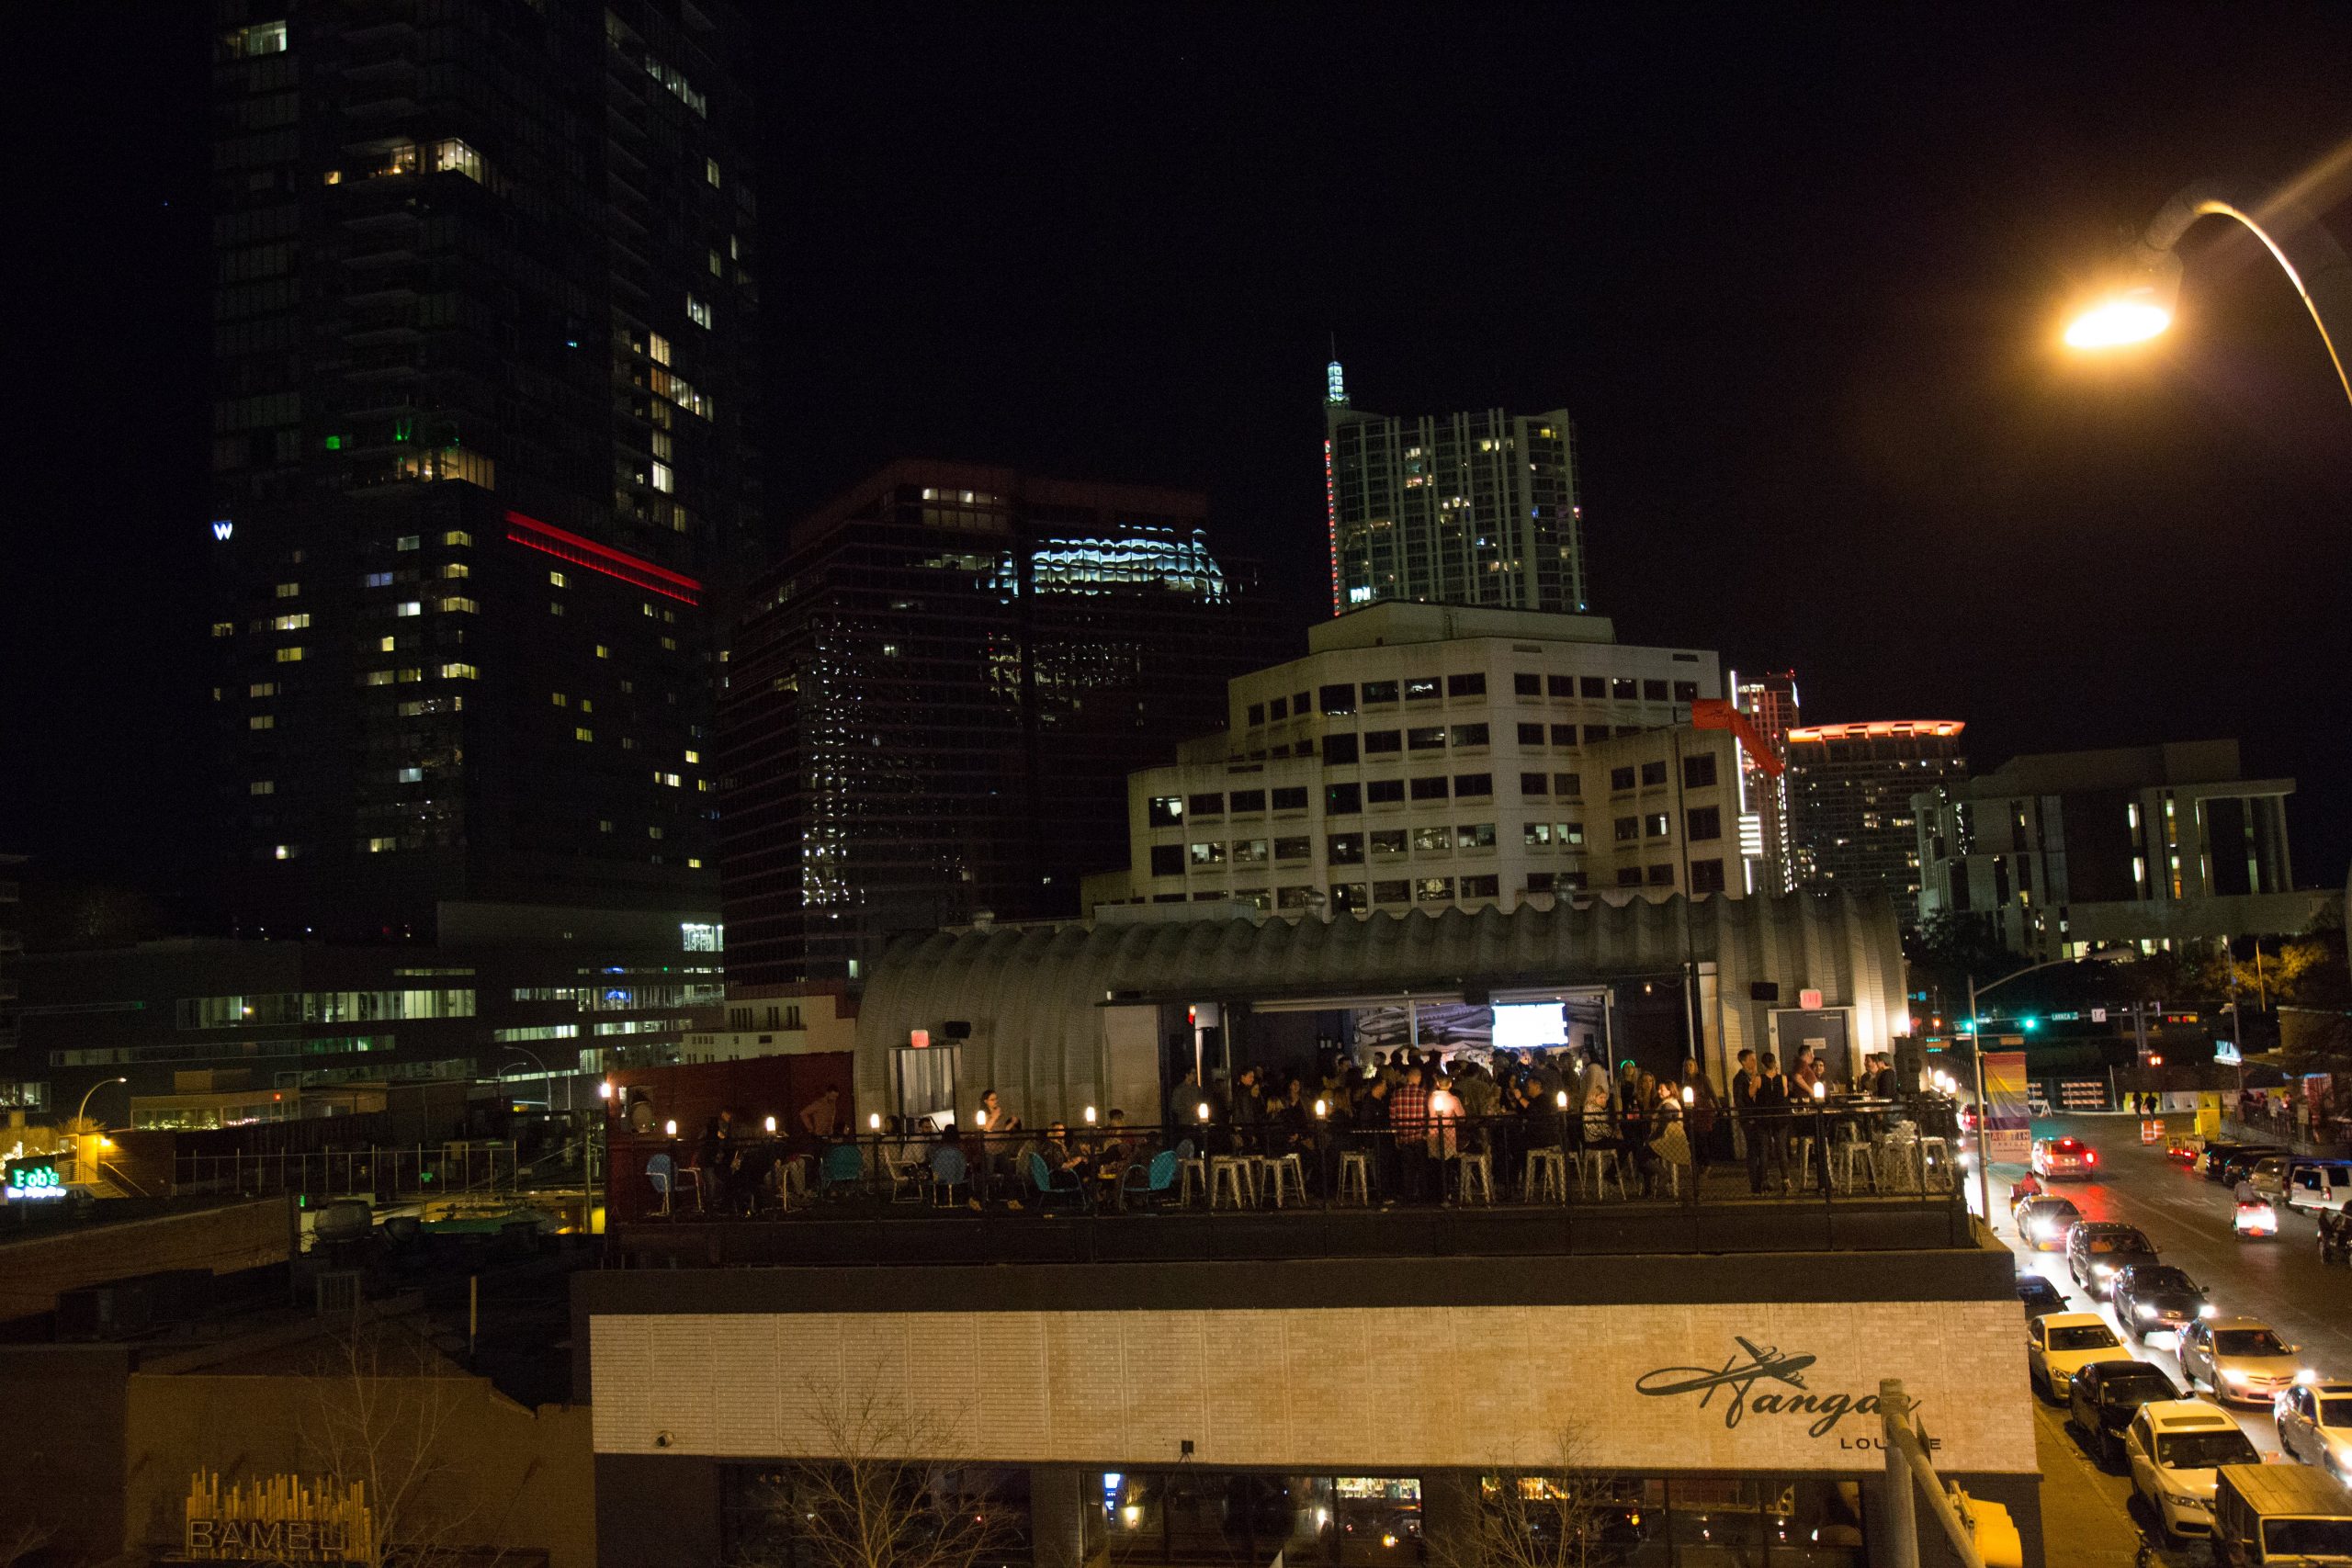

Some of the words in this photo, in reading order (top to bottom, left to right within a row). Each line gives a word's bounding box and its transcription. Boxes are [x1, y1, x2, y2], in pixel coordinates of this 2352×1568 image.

[1991, 1131, 2030, 1141] AUTIN
[1840, 1438, 1942, 1450] LOUE
[189, 1520, 345, 1551] BAMBU
